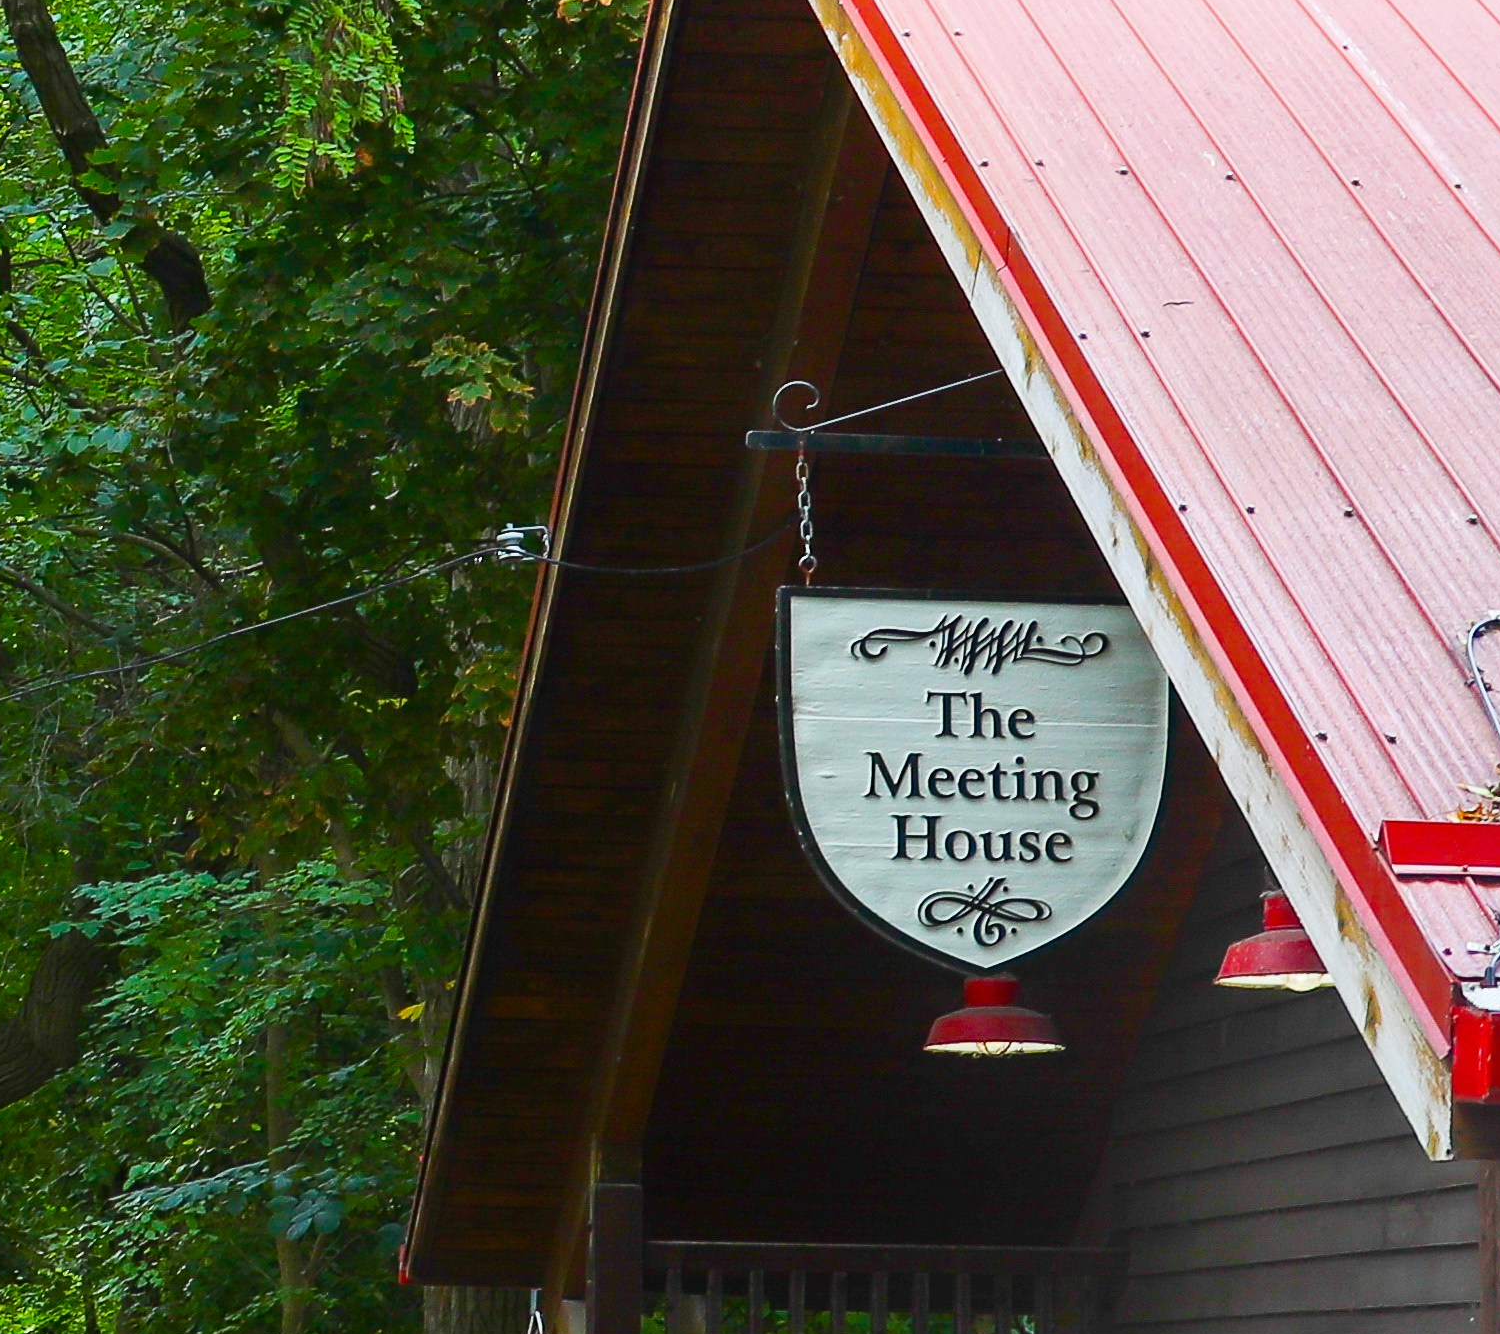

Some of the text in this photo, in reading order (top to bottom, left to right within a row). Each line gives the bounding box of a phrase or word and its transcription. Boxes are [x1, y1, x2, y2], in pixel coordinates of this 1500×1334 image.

[926, 691, 1036, 741] The
[863, 751, 1101, 822] Meeting
[890, 814, 1074, 864] House
